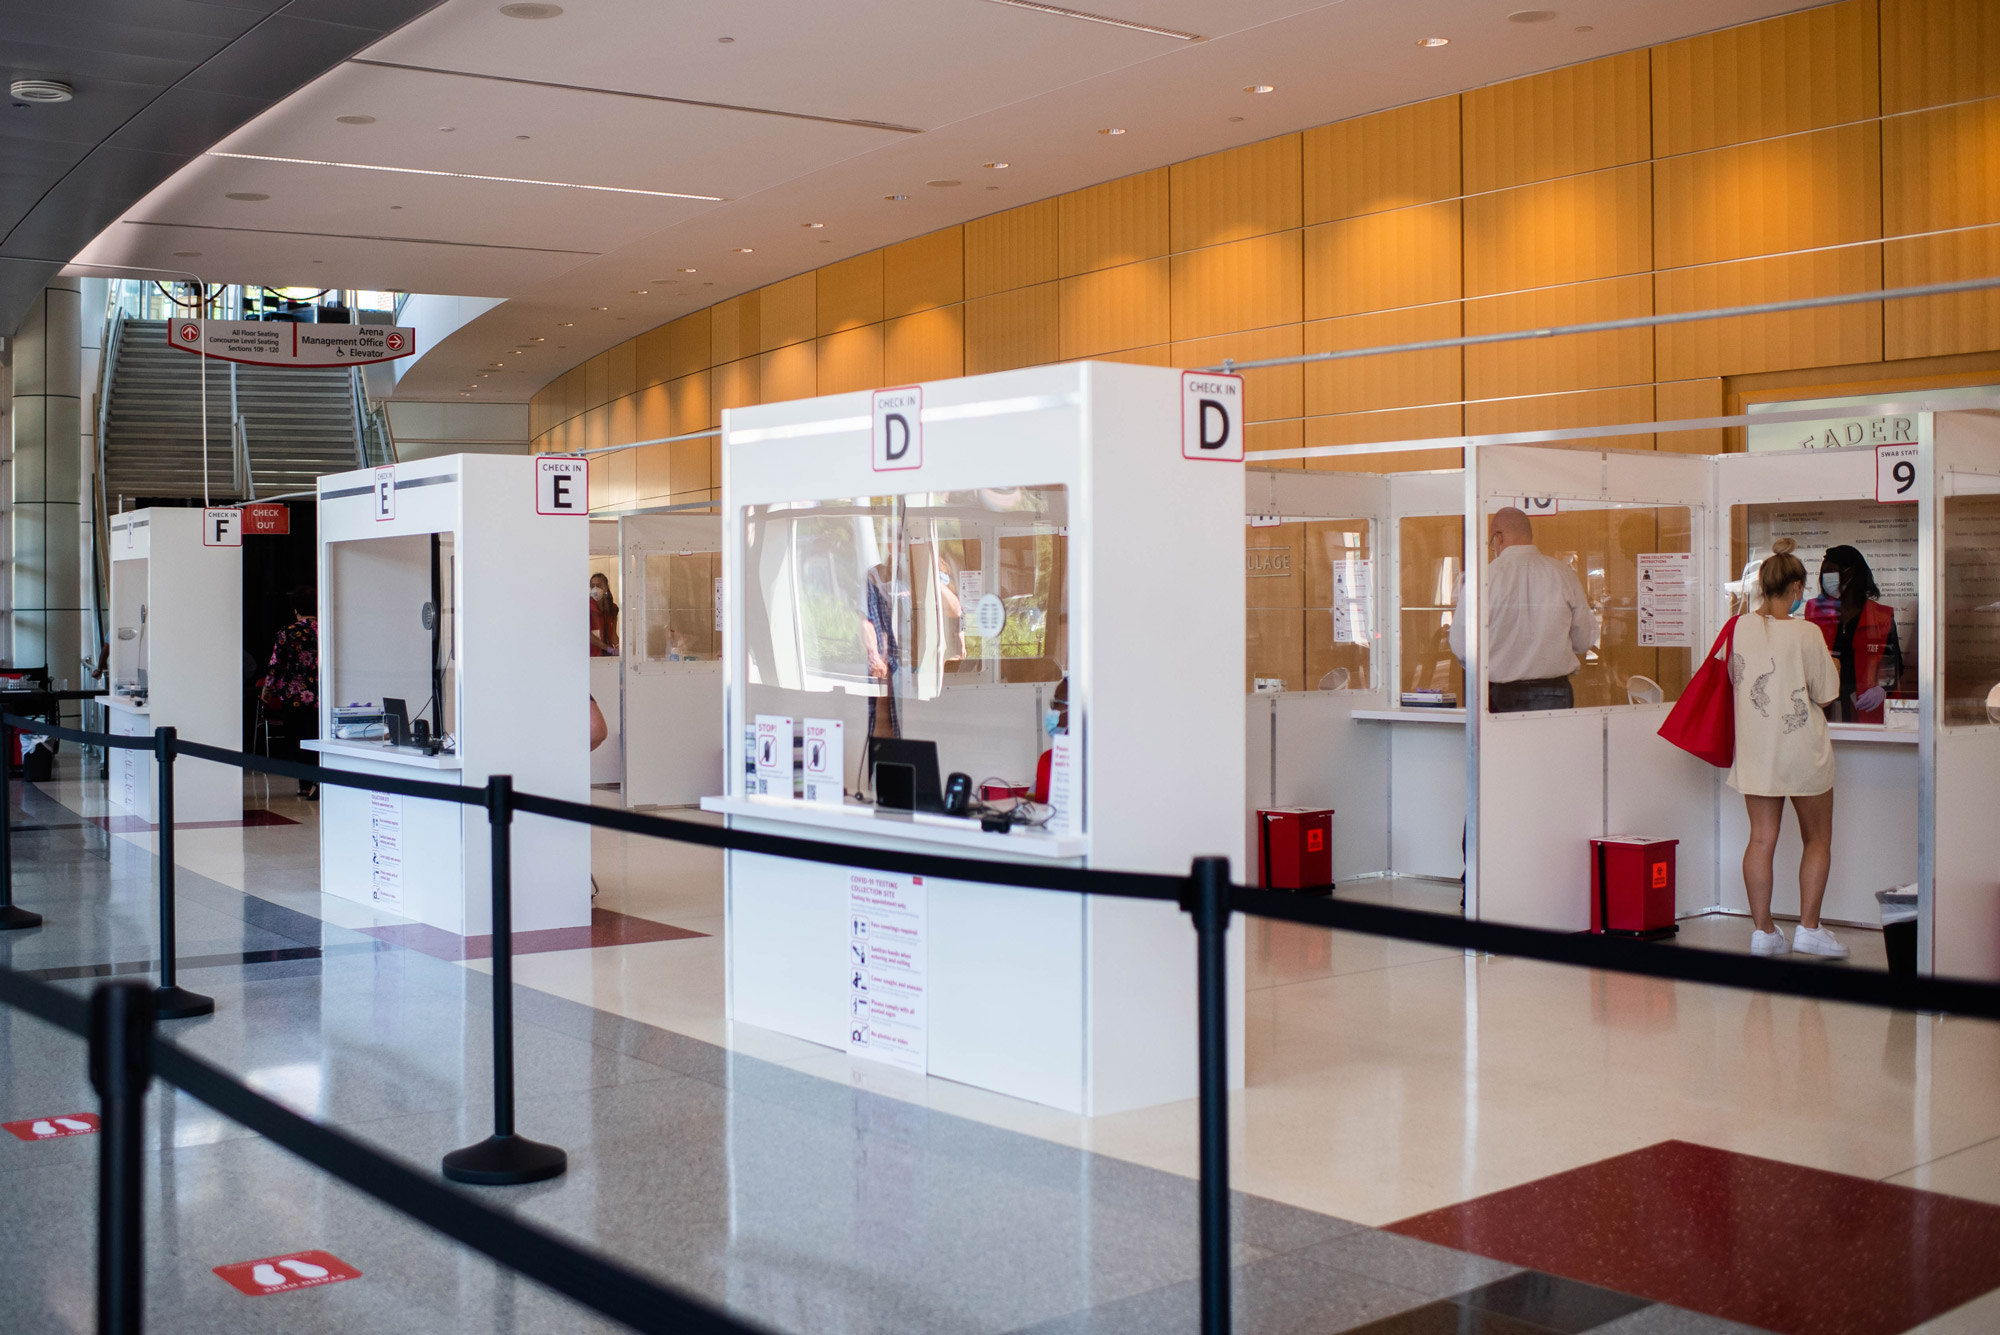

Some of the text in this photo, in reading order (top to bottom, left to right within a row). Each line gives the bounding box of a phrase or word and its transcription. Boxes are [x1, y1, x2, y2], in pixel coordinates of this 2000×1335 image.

[359, 327, 384, 336] Arena
[301, 336, 384, 347] Management Office
[350, 349, 384, 357] Elevator
[1189, 381, 1236, 395] CHECK IN
[878, 396, 916, 409] CHECK IN
[1200, 398, 1230, 450] D
[885, 413, 910, 461] D
[542, 464, 582, 472] CHECK IN
[377, 472, 393, 481] CHECK IN
[1892, 460, 1916, 494] 9
[380, 482, 389, 514] E
[553, 475, 572, 508] E
[252, 509, 279, 517] CHECK
[216, 520, 230, 542] F
[1248, 554, 1290, 570] LLAGE
[851, 885, 895, 899] COLLECTION SITE
[876, 880, 898, 890] TESTING
